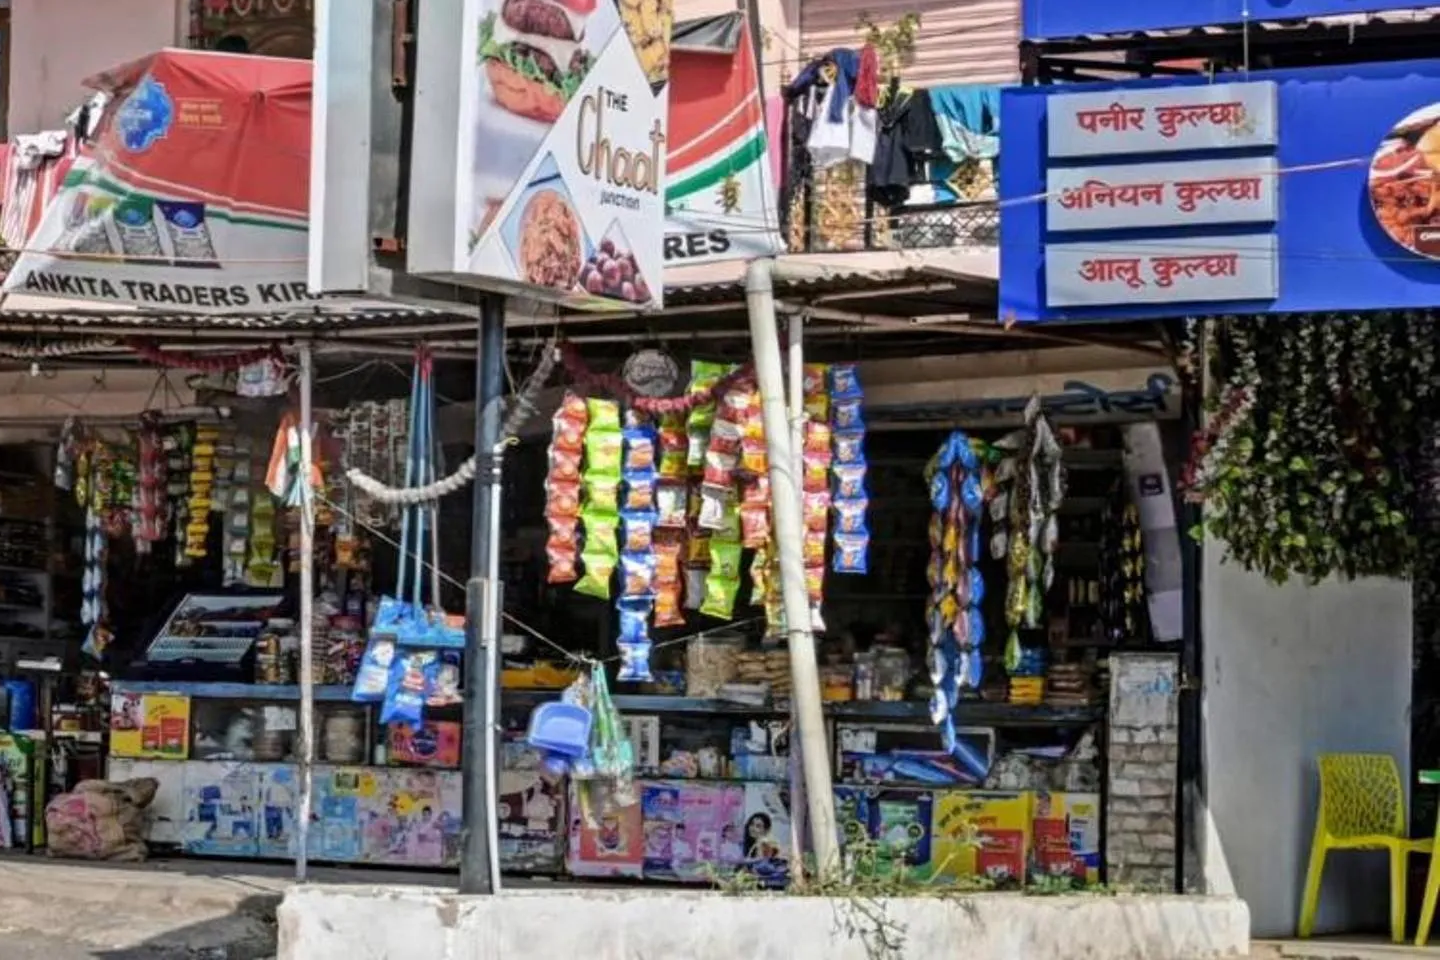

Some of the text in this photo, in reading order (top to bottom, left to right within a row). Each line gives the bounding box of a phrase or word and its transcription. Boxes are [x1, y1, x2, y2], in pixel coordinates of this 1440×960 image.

[605, 89, 628, 112] THE
[1076, 102, 1145, 133] पनीर
[577, 85, 665, 195] Chaat
[1058, 178, 1262, 211] अनियन कुल्छा
[663, 229, 730, 260] RES
[1079, 253, 1238, 288] आलू कुल्छा
[26, 270, 323, 306] ANKITA TRADERS KIR
